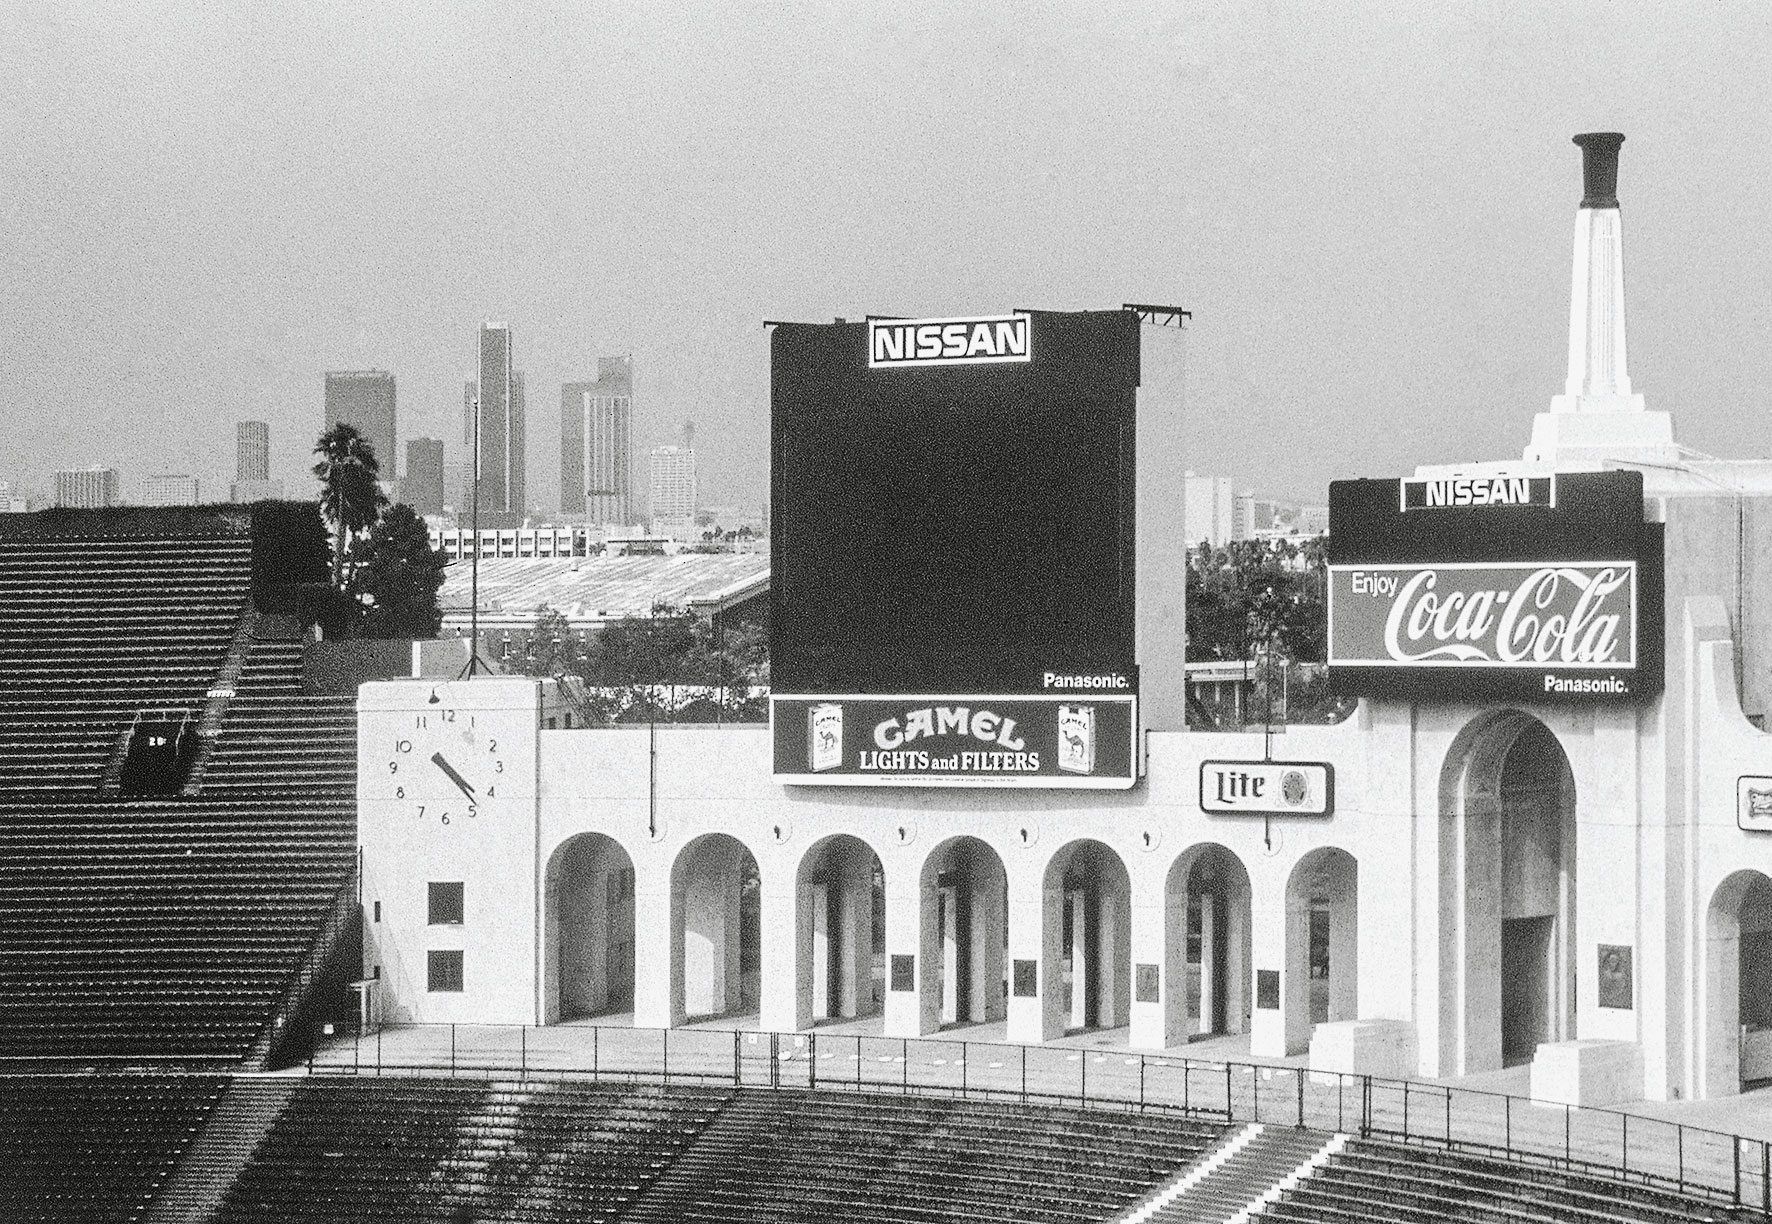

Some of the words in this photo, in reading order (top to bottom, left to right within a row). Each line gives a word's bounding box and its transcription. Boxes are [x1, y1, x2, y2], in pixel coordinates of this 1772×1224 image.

[875, 321, 1026, 360] NISSAN
[1425, 478, 1530, 507] NISSAN
[1351, 571, 1399, 598] Enjoy
[1384, 568, 1630, 663] Coca-Cola
[441, 709, 456, 722] 12
[416, 716, 427, 729] 11
[873, 706, 1025, 751] CAMEL
[395, 740, 412, 753] 10
[489, 739, 497, 752] 2
[495, 760, 503, 773] 3
[859, 750, 930, 770] LIGHTS
[931, 753, 959, 770] and
[961, 751, 1040, 771] FILTERS
[389, 761, 398, 774] 9
[396, 786, 405, 799] 8
[487, 786, 495, 798] 4
[1214, 771, 1265, 804] Lite
[417, 805, 425, 818] 7
[468, 805, 477, 818] 5
[441, 812, 450, 825] 6
